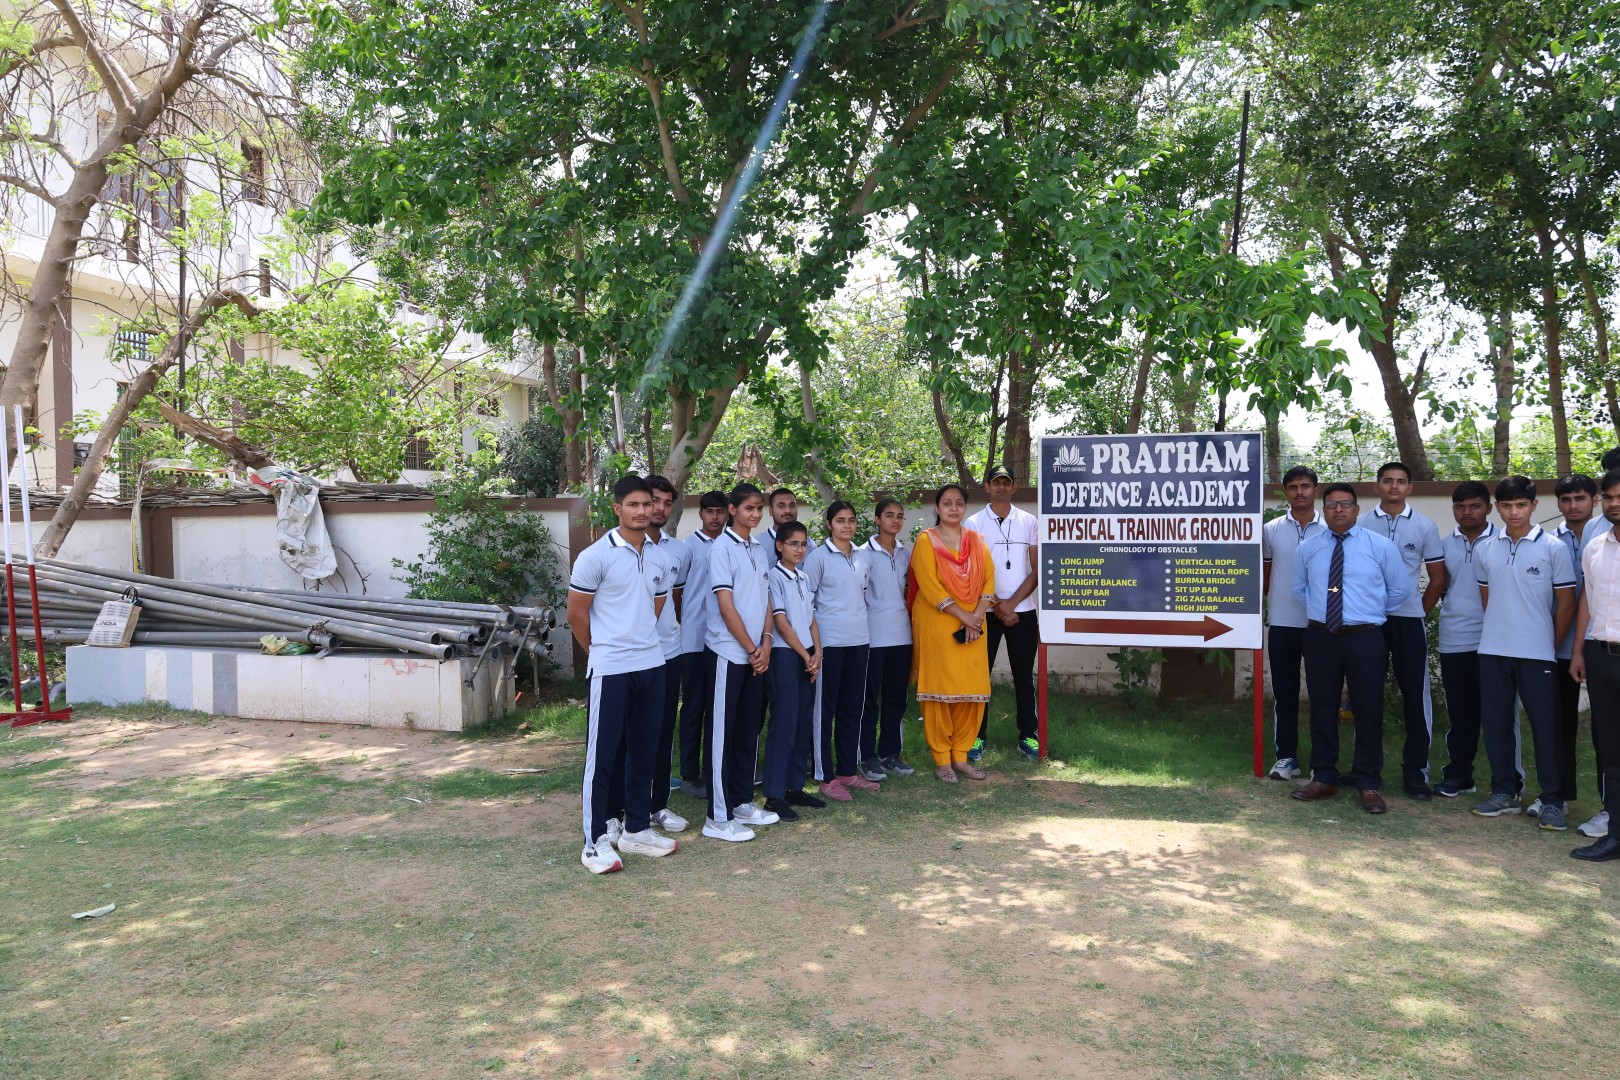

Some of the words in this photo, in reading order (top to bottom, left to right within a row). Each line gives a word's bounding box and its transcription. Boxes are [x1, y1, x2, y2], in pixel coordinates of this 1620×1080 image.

[1091, 440, 1250, 474] PRATHAM
[1051, 482, 1142, 508] DEFENCE
[1146, 480, 1249, 507] ACADEMY
[1048, 518, 1114, 541] PHYSICAL
[1117, 518, 1186, 541] TRAINING
[1190, 518, 1253, 540] GROUND
